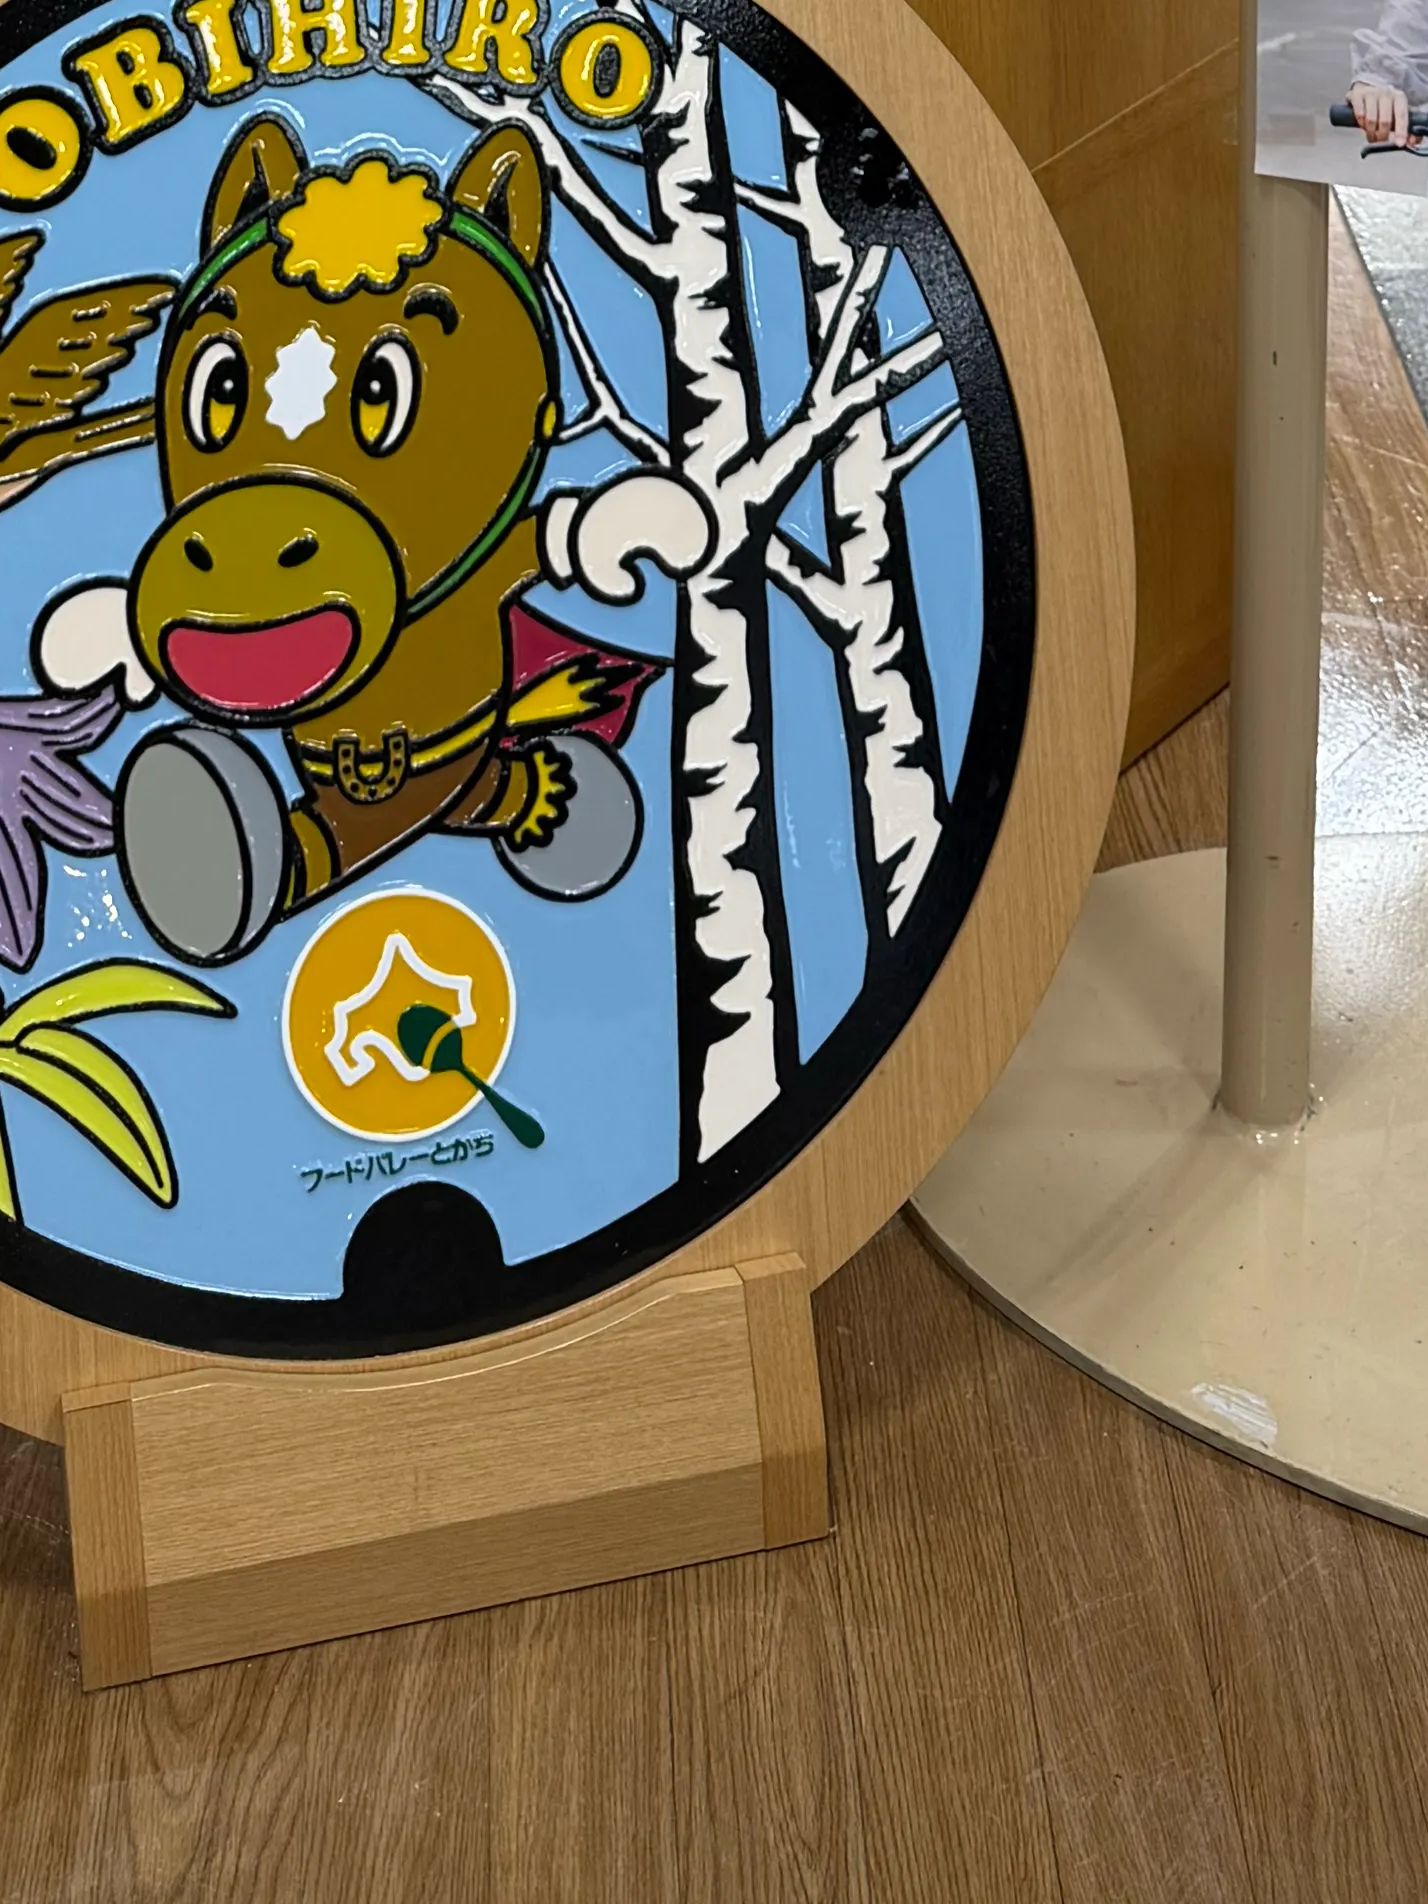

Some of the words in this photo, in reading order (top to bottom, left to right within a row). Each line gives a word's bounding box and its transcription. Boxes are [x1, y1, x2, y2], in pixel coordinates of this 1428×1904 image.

[299, 1132, 495, 1193] フードバレーとかち
